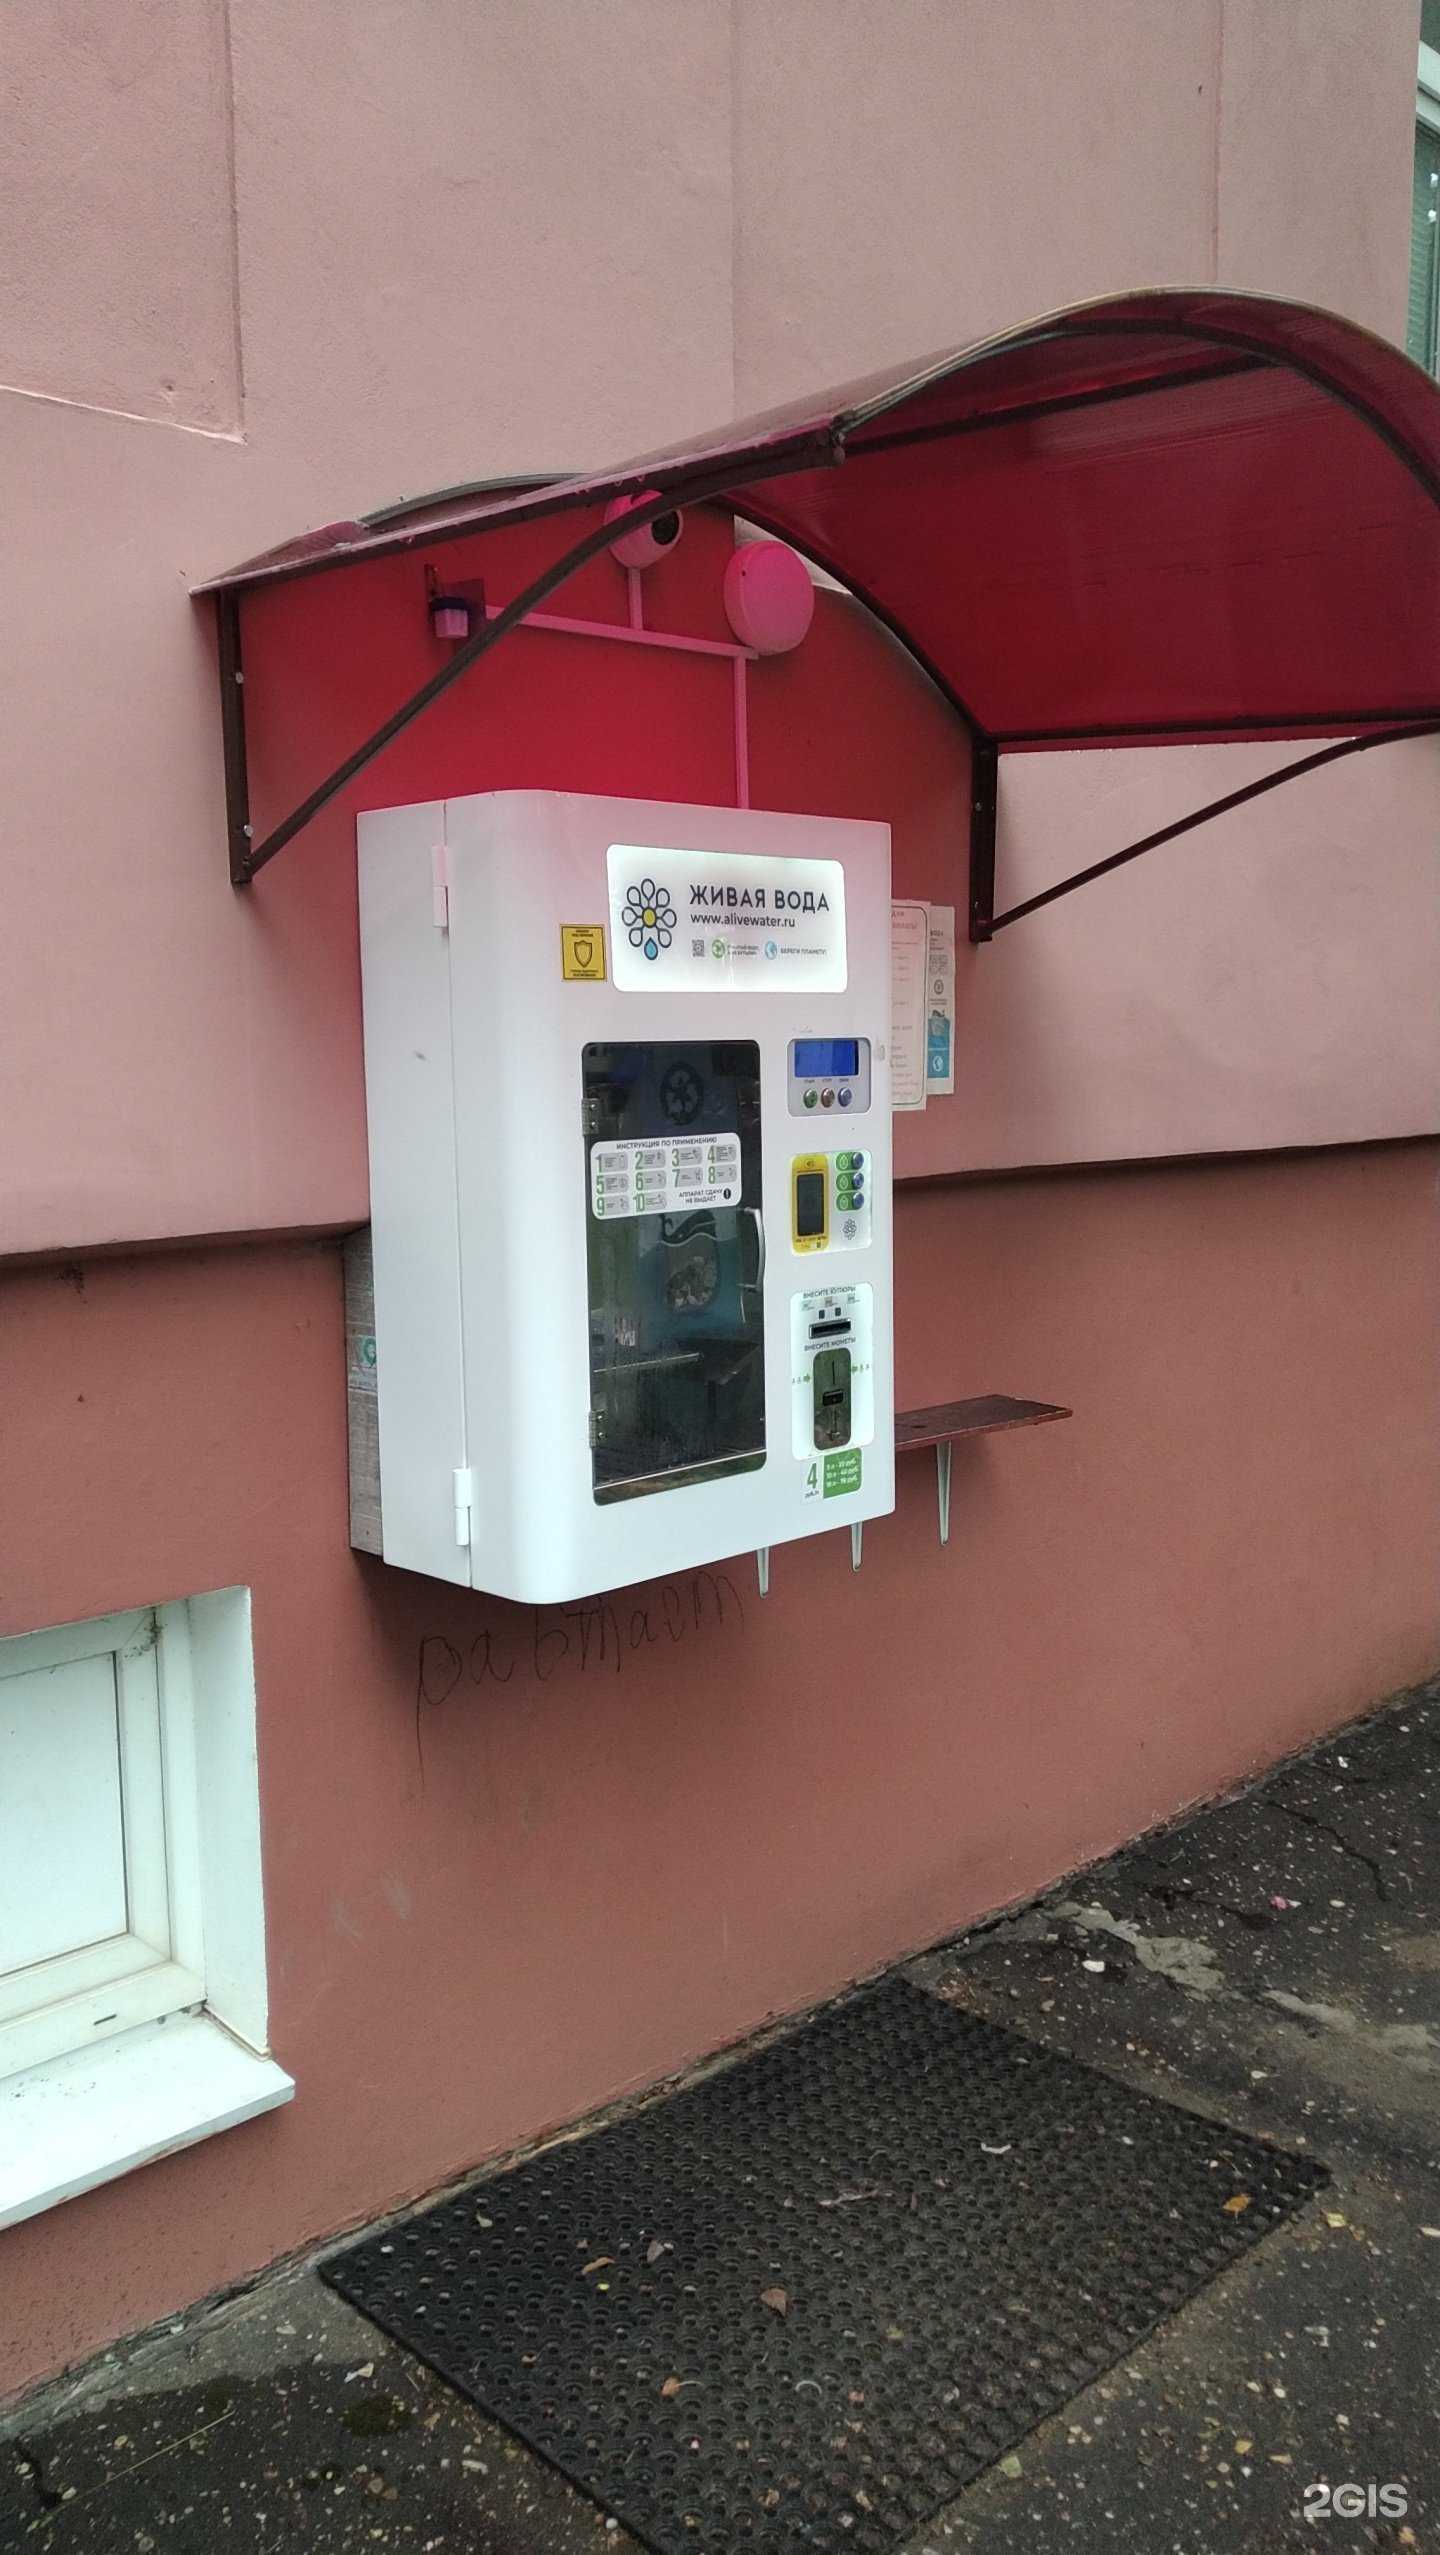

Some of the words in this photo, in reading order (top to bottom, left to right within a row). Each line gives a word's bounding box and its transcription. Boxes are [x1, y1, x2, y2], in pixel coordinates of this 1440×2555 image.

[689, 884, 765, 908] ЖИВАЯ
[774, 889, 830, 914] ВОДА
[690, 913, 795, 927] www.alivewater.ru
[616, 1141, 660, 1149] ИНСТРУКЦИЯ
[661, 1139, 671, 1147] ПО
[672, 1137, 717, 1145] ПРИМЕНЕНИЮ
[594, 1153, 603, 1173] 1
[634, 1151, 643, 1170] 2
[671, 1148, 680, 1167] 3
[707, 1145, 716, 1163] 4
[635, 1172, 644, 1191] 6
[672, 1169, 680, 1188] 7
[708, 1166, 716, 1184] 8
[596, 1175, 605, 1195] 5
[596, 1197, 605, 1216] 9
[633, 1193, 645, 1212] 10
[807, 1463, 818, 1489] 4
